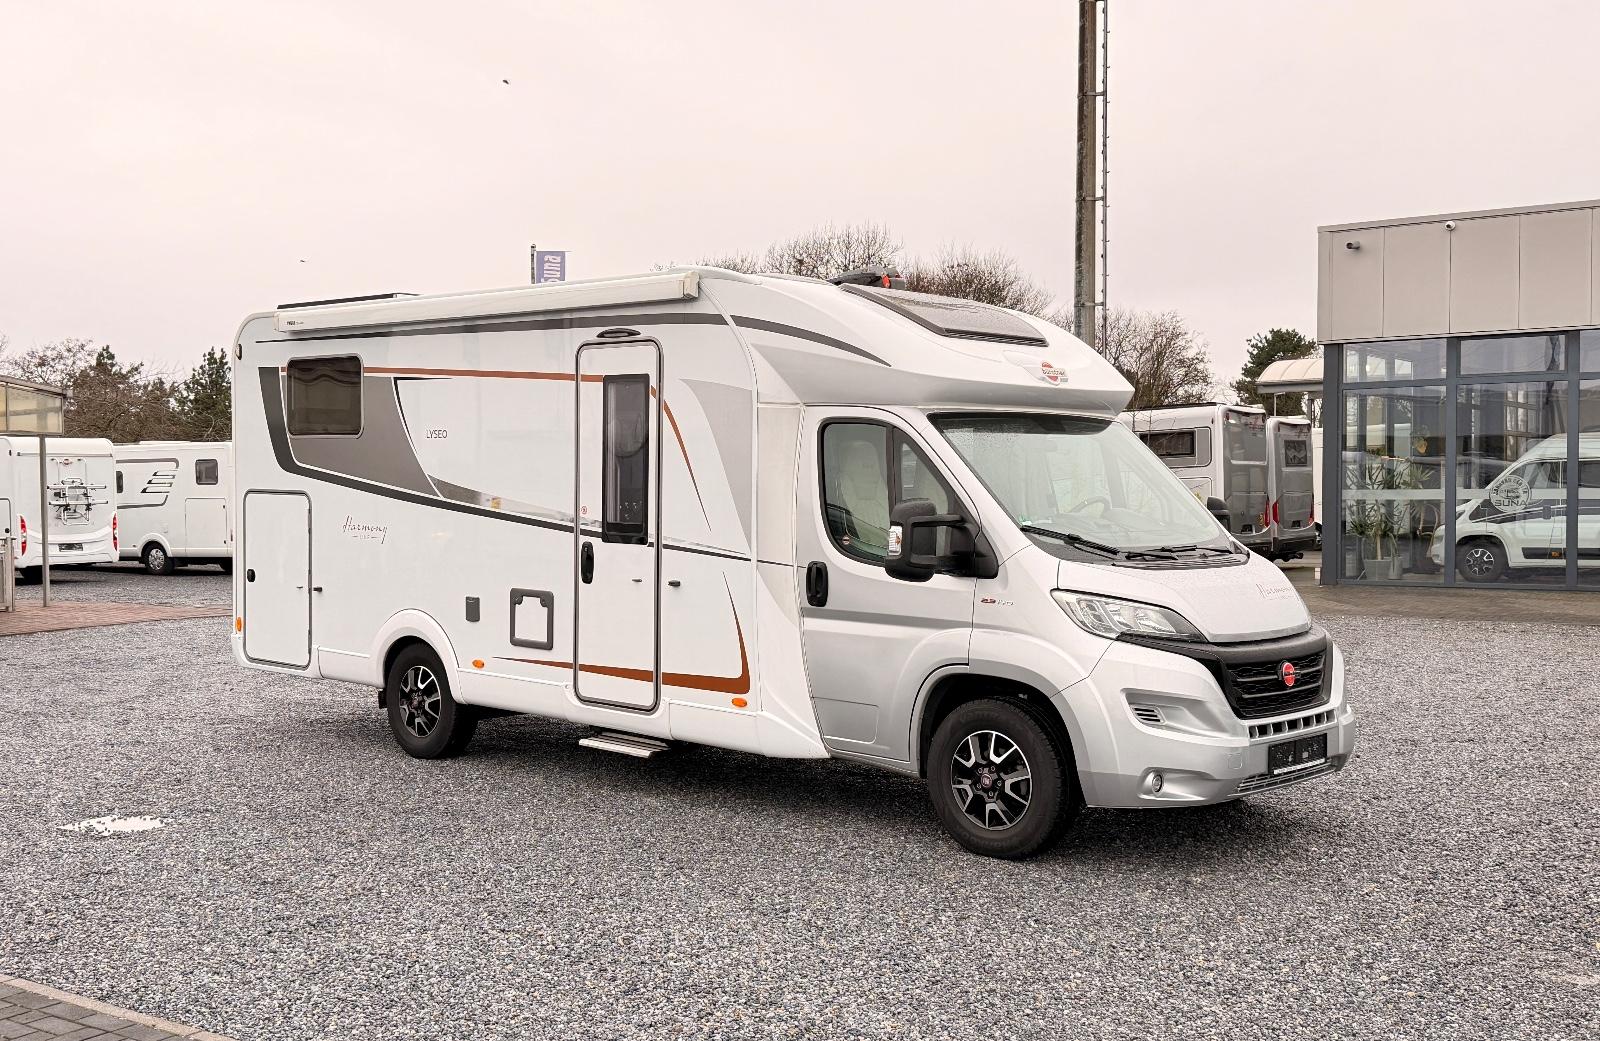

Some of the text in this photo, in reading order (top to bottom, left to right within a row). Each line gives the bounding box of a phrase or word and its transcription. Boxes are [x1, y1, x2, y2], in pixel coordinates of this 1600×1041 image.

[426, 429, 448, 439] LYSEO
[1494, 499, 1528, 507] SUNA
[342, 514, 388, 545] Harmony
